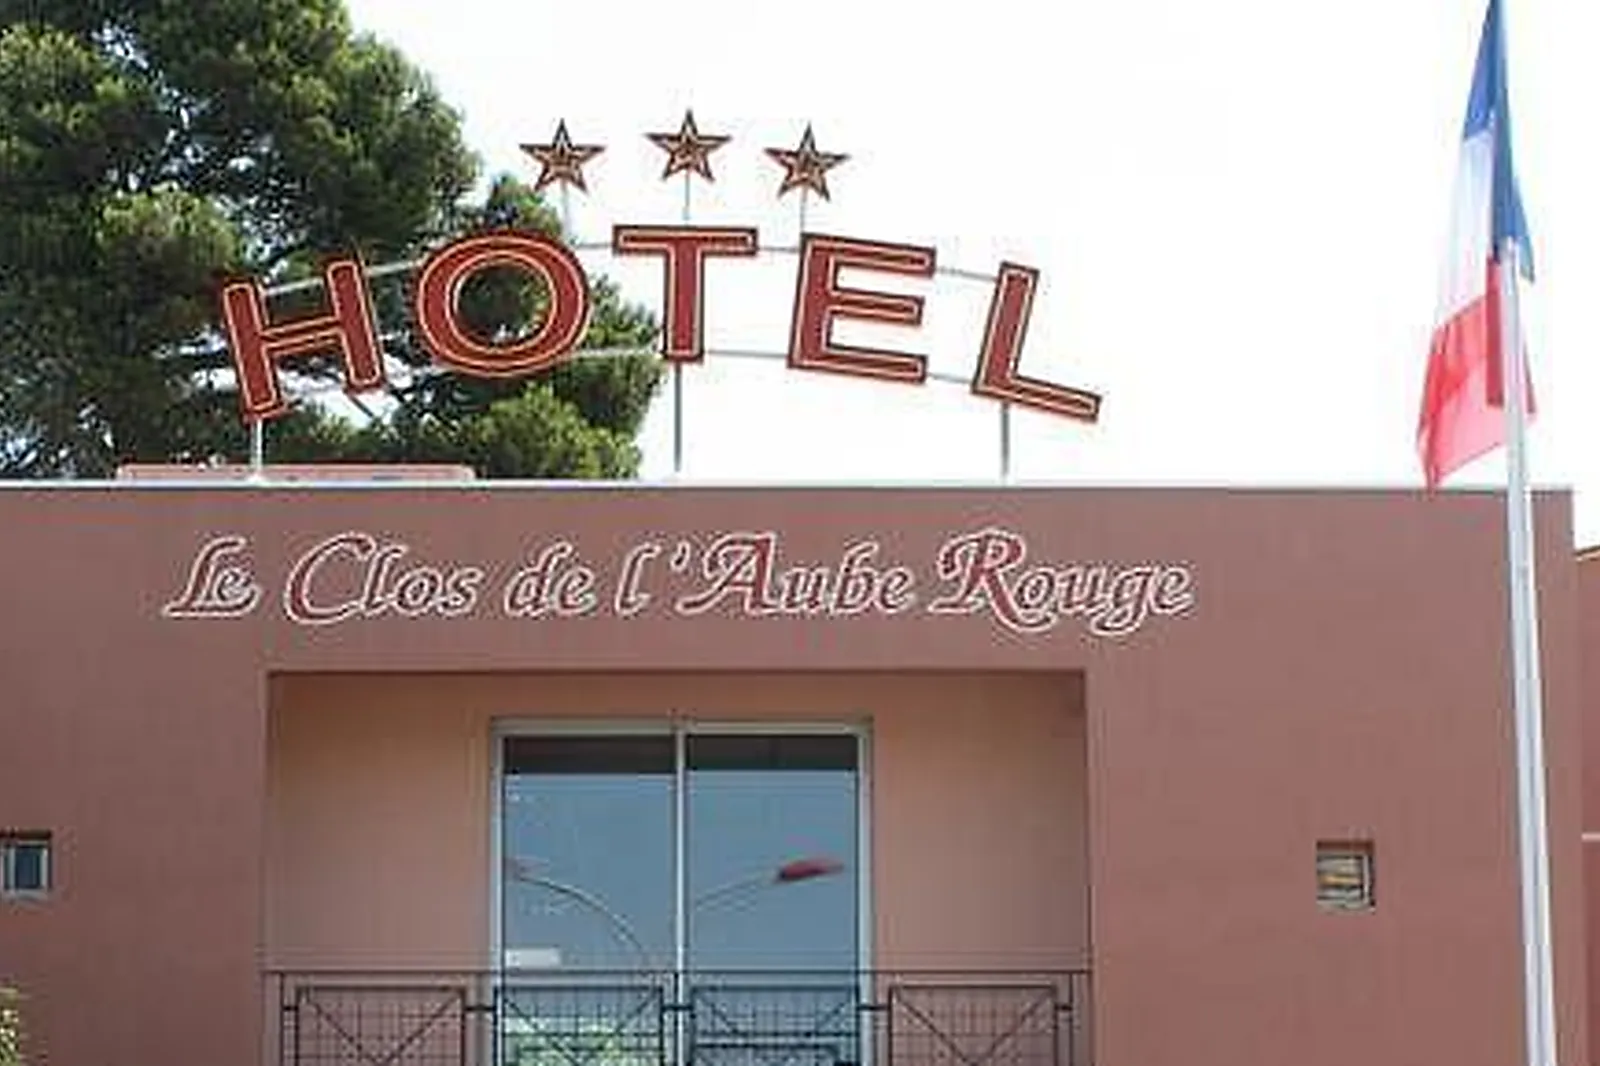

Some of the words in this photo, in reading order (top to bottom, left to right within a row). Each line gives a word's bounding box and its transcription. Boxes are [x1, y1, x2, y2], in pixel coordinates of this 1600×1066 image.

[221, 223, 1103, 424] HOTEL
[162, 533, 261, 619] Le
[283, 531, 485, 626] Clos
[503, 540, 597, 619] de
[928, 527, 1196, 637] Rouge
